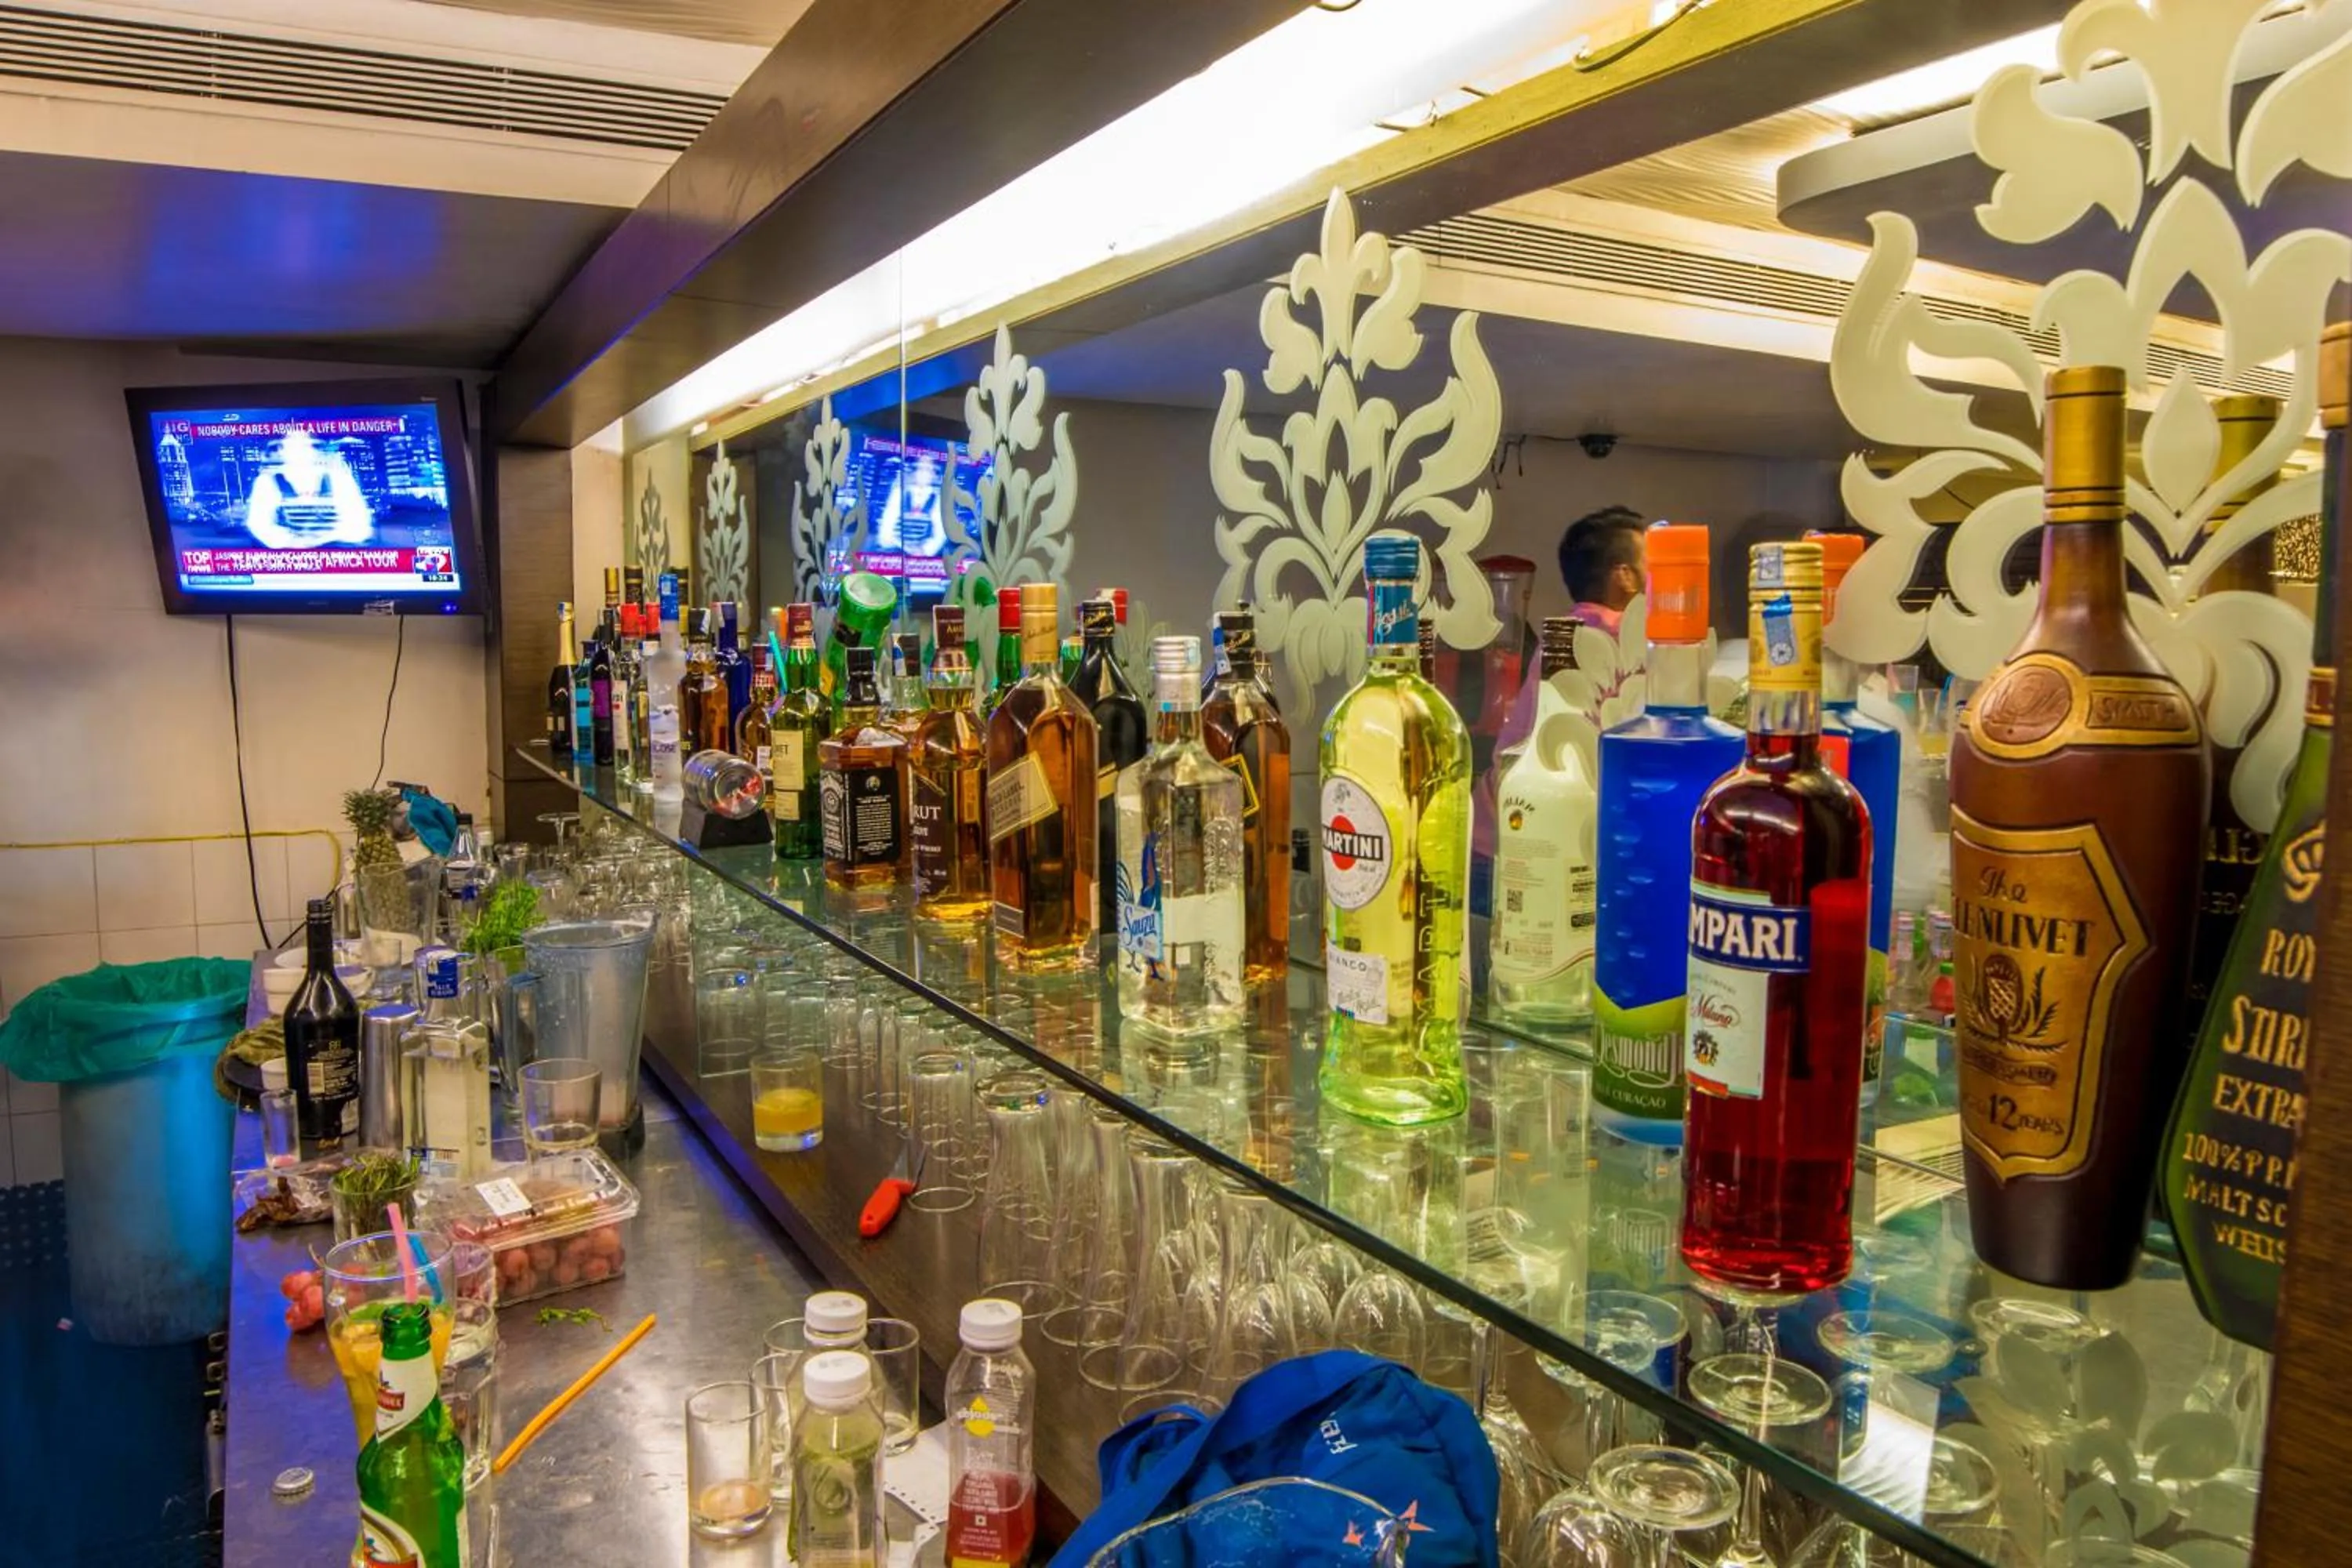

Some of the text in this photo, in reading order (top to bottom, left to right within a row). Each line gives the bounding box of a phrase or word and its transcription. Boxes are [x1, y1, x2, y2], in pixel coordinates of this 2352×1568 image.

[238, 423, 270, 436] CARES
[316, 422, 336, 433] LIFE
[338, 420, 350, 433] IN
[352, 419, 393, 432] DANGER
[186, 551, 210, 565] TOP
[1979, 865, 2028, 903] The
[1987, 1094, 2019, 1131] 12
[2211, 1073, 2307, 1128] EXTRA
[2183, 1174, 2253, 1218] MALT
